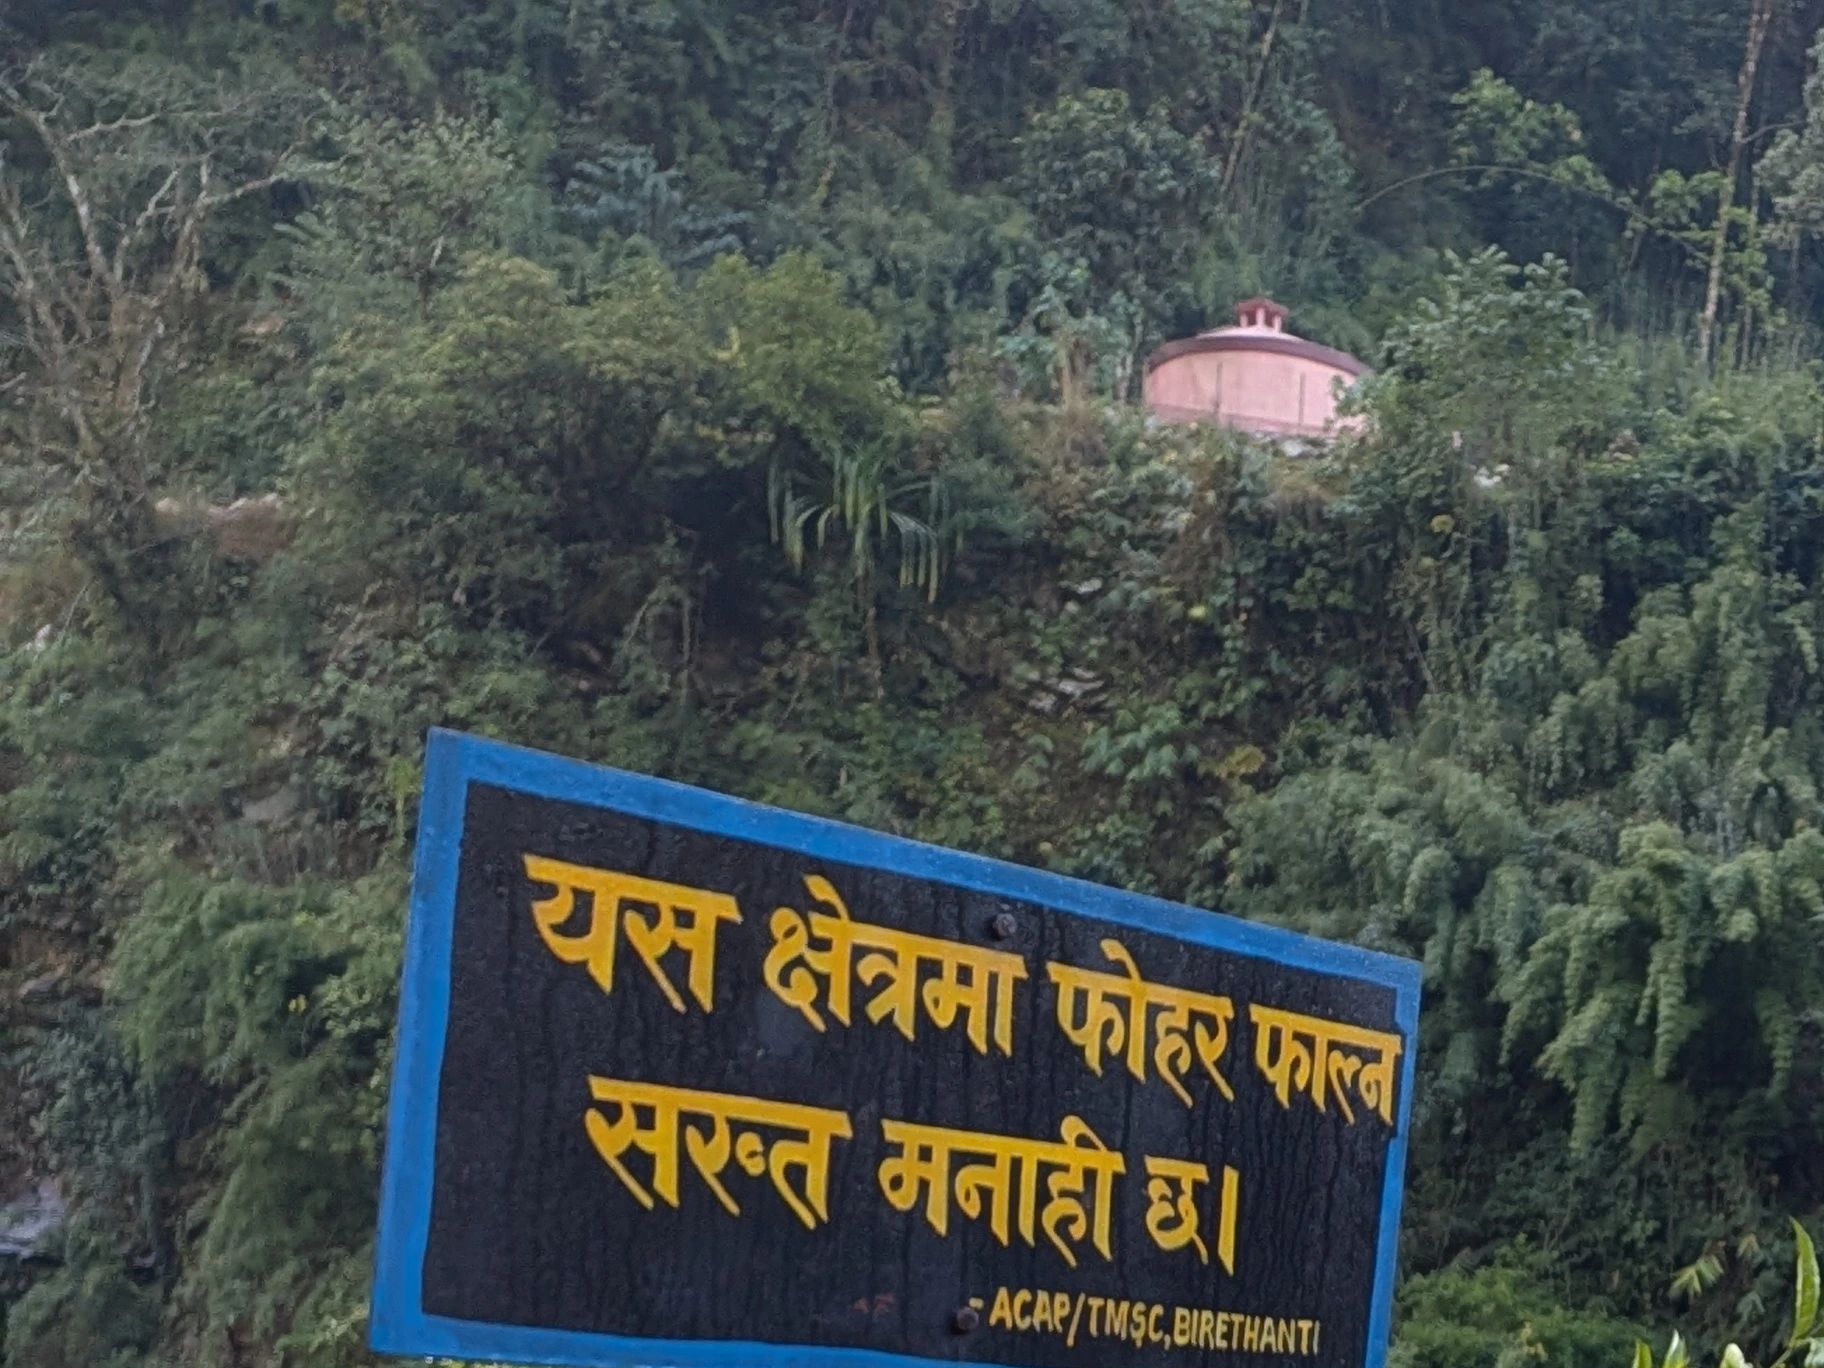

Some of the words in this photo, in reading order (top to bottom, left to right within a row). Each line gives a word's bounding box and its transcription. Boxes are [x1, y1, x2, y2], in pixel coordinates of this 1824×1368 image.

[524, 854, 743, 1013] यस
[762, 873, 1029, 1057] क्षेत्रमा
[1045, 937, 1235, 1109] फोहर
[1248, 1002, 1403, 1127] फाल्न
[584, 1074, 853, 1230] सख्त
[877, 1114, 1126, 1268] मनाही
